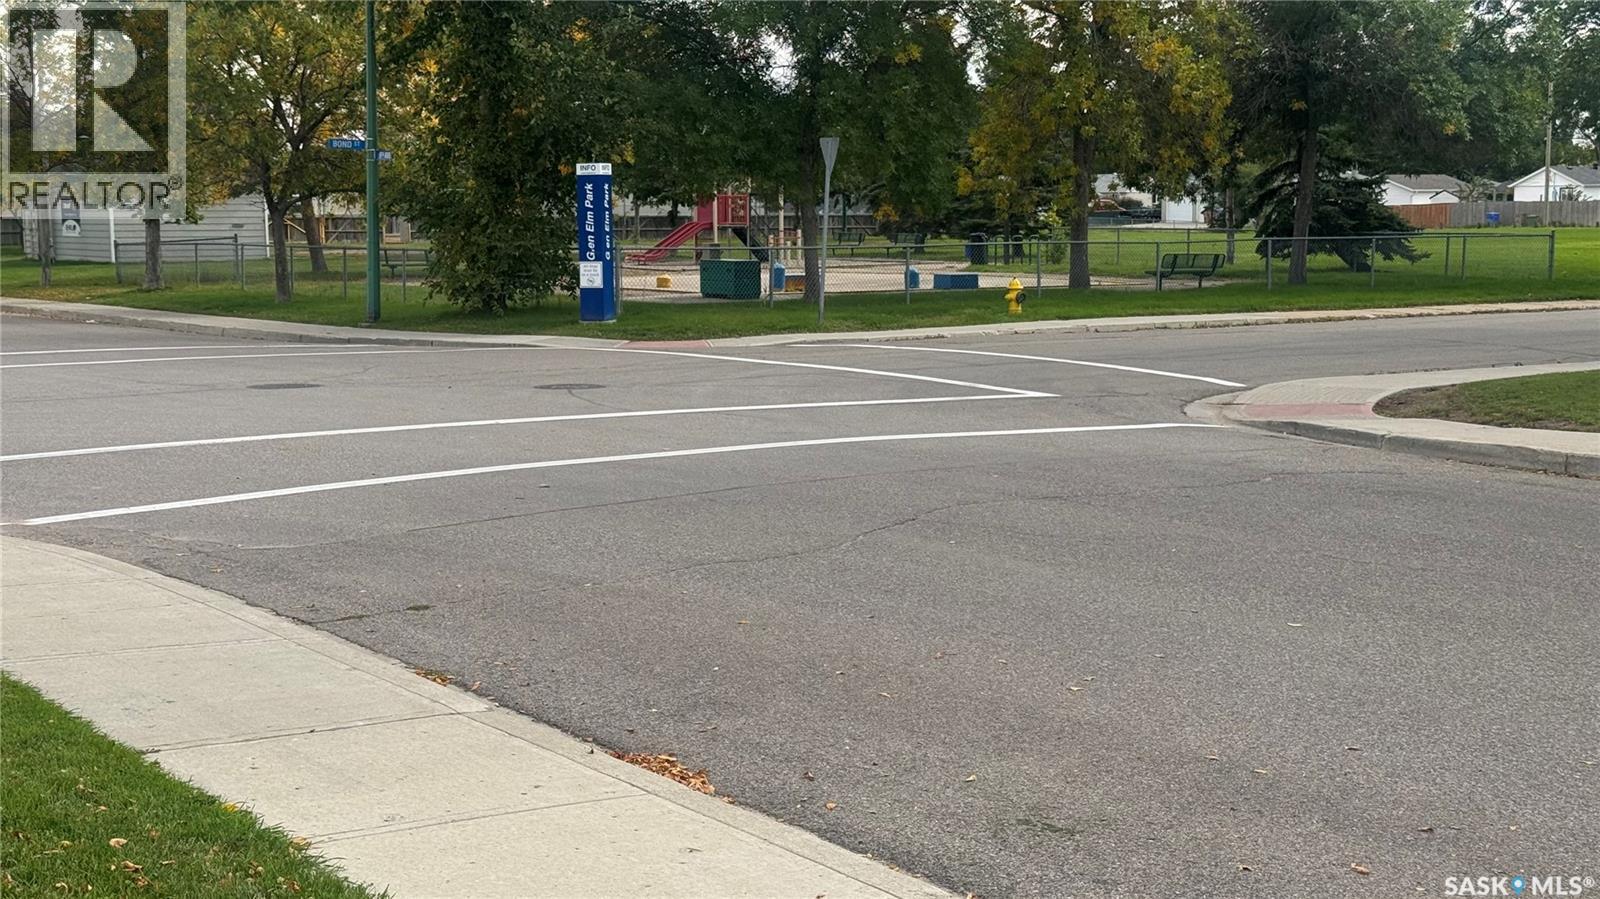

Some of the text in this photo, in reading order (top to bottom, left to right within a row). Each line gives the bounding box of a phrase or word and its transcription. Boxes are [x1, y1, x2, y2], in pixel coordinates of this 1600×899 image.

[332, 140, 352, 148] BOND
[584, 183, 594, 208] Park
[585, 211, 595, 232] Elm
